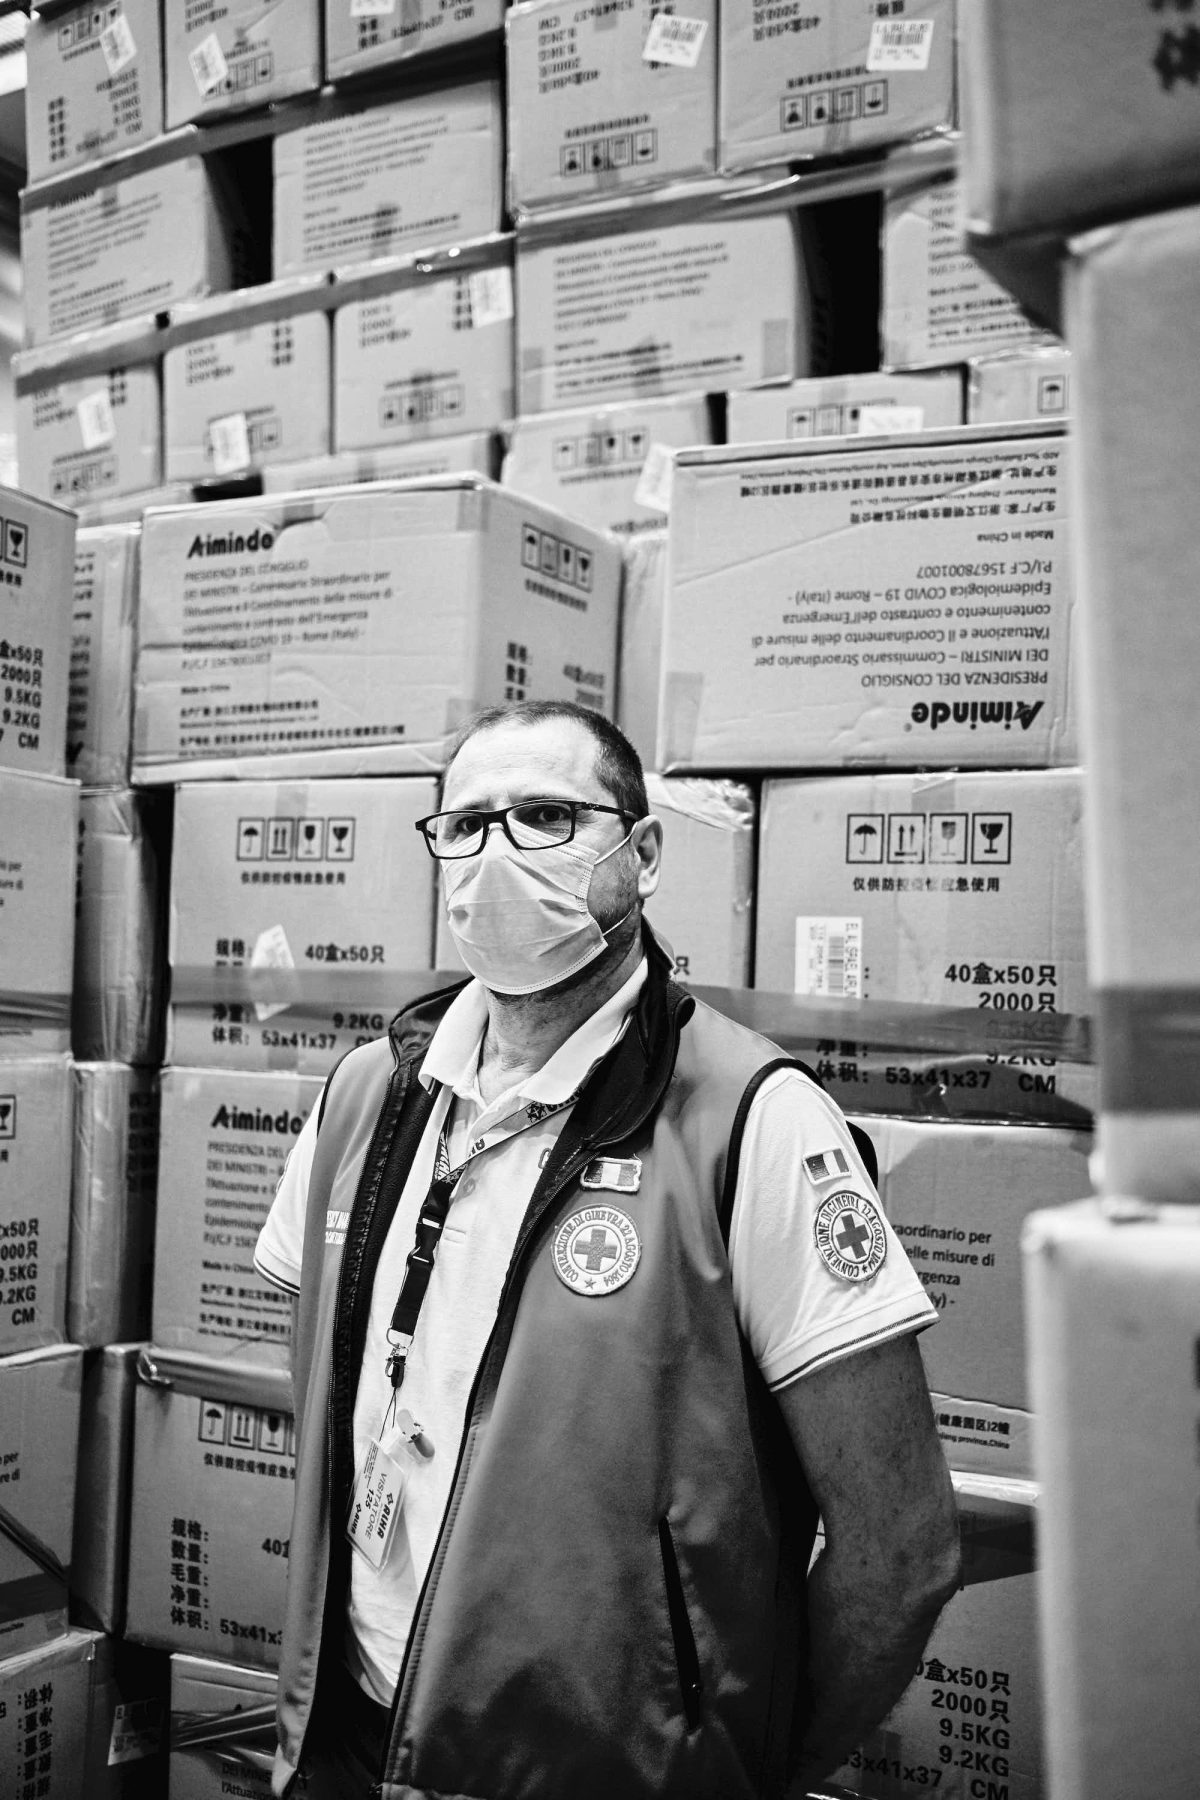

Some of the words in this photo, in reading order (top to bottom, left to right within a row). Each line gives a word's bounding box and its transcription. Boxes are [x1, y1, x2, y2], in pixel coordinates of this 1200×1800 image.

[977, 533, 1008, 543] China
[1011, 531, 1022, 542] in
[1024, 529, 1054, 540] Made
[917, 563, 1006, 579] 15678001007
[795, 590, 831, 605] (Italy)
[835, 590, 870, 602] Rome
[886, 589, 899, 600] 19
[905, 587, 946, 600] COVID
[950, 582, 1051, 599] Epidemiologica
[783, 610, 877, 625] dell'Emergenza
[880, 608, 941, 622] contrasto
[945, 608, 952, 617] e
[957, 604, 1050, 619] contenimento
[766, 634, 807, 647] misure
[811, 633, 841, 646] delle
[845, 630, 945, 644] Coordinamento
[948, 630, 955, 642] il
[959, 629, 967, 638] e
[972, 626, 1049, 641] l'Attuazione
[752, 636, 763, 649] di
[754, 654, 774, 667] per
[778, 653, 858, 668] Straordinario
[862, 651, 945, 665] Commissario
[961, 649, 1022, 663] MINISTRI
[1026, 649, 1049, 662] DEI
[1, 663, 43, 689] 2000只
[861, 673, 932, 687] CONSIGLIO
[936, 673, 960, 684] DEL
[965, 671, 1048, 684] PRESIDENZA
[4, 686, 42, 708] 9.5KG
[3, 708, 40, 729] 9.2KG
[911, 701, 1044, 730] Aiminde
[18, 732, 40, 750] CM
[945, 962, 1057, 987] 40盒x50只
[979, 992, 1057, 1014] 2000只
[332, 1012, 384, 1031] 9.2KG
[262, 1030, 337, 1049] 53x41x37
[885, 1067, 991, 1088] 53x41x37
[1018, 1073, 1056, 1094] CM
[968, 1232, 992, 1245] per
[902, 1245, 929, 1259] elle
[932, 1249, 978, 1265] misure
[981, 1253, 995, 1267] di
[12, 1307, 35, 1326] CM
[365, 1488, 374, 1510] 125
[365, 1472, 388, 1540] VISITATORE
[931, 1688, 1010, 1724] 2000只
[939, 1717, 1010, 1750] 9.5KG
[939, 1745, 1009, 1778] 9.2KG
[842, 1751, 943, 1788] 3x41x37
[970, 1778, 1009, 1800] CM
